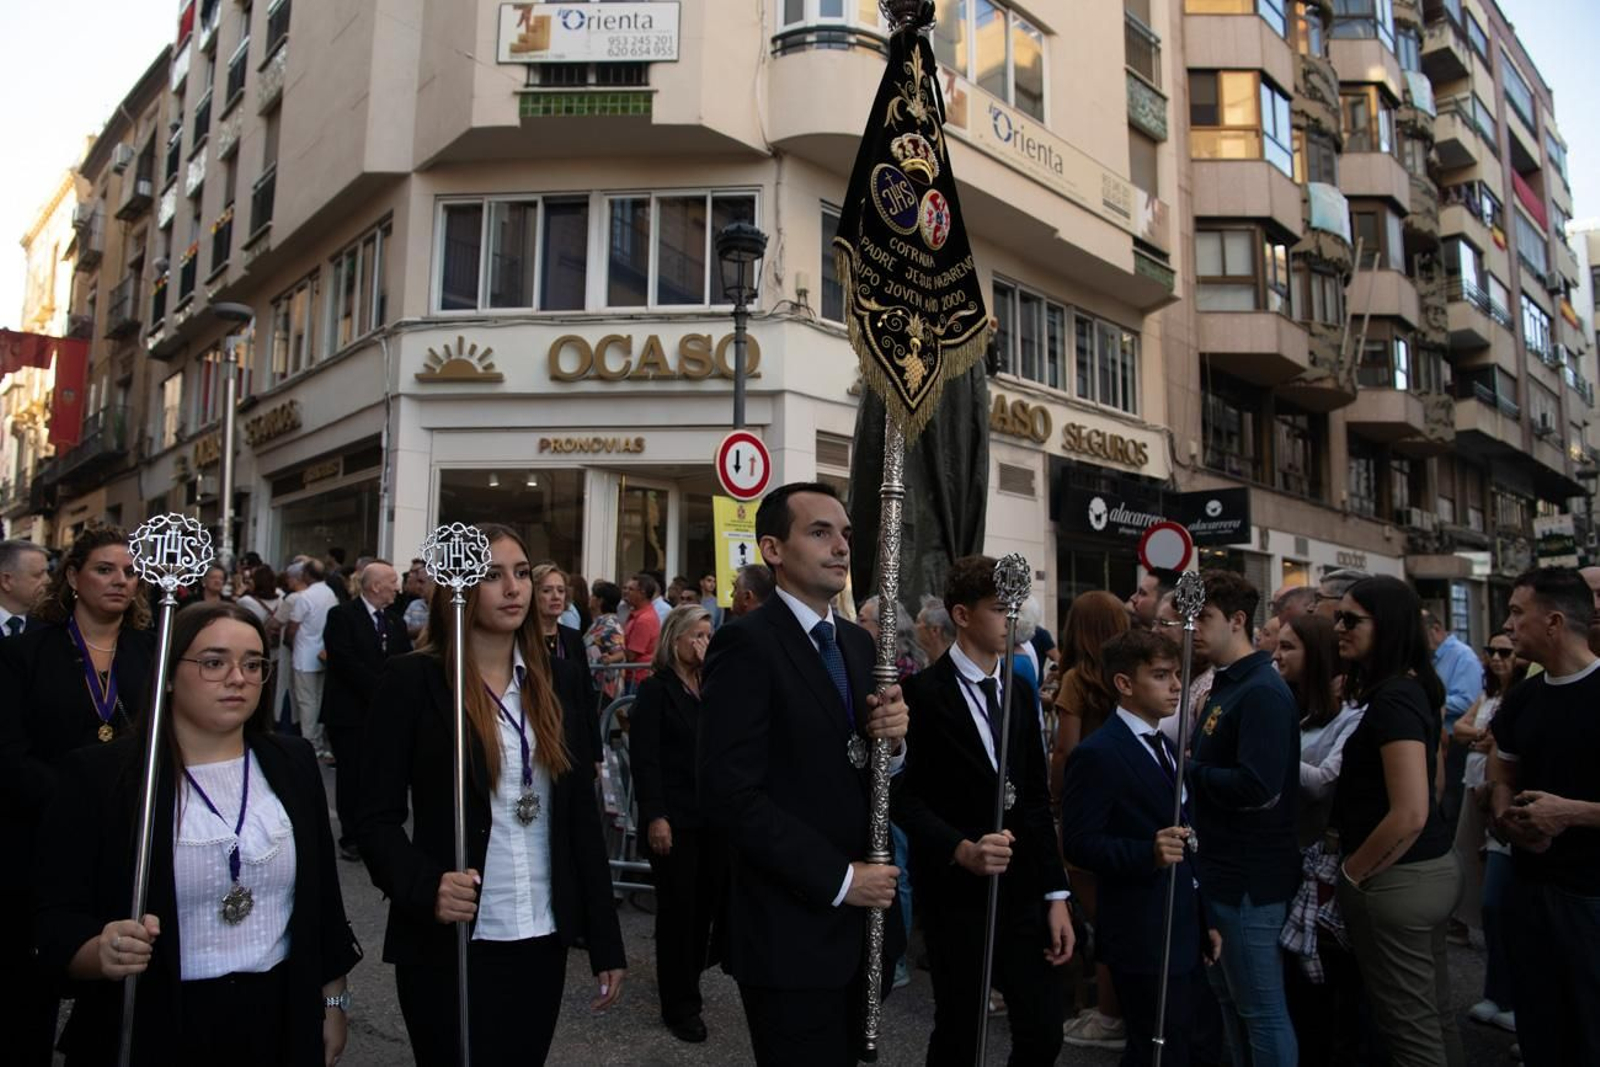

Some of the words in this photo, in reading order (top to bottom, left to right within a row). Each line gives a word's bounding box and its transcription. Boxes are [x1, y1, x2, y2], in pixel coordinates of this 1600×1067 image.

[560, 9, 654, 30] Orienta
[608, 35, 628, 46] 953
[991, 109, 1064, 175] Orienta
[860, 236, 898, 272] PADRE
[941, 289, 966, 311] 2000
[548, 332, 762, 381] OCASO
[989, 393, 1053, 444] ASO
[1061, 422, 1149, 469] SEGUROS
[538, 436, 646, 454] PRONOVIAS
[1109, 501, 1167, 528] alacarrer
